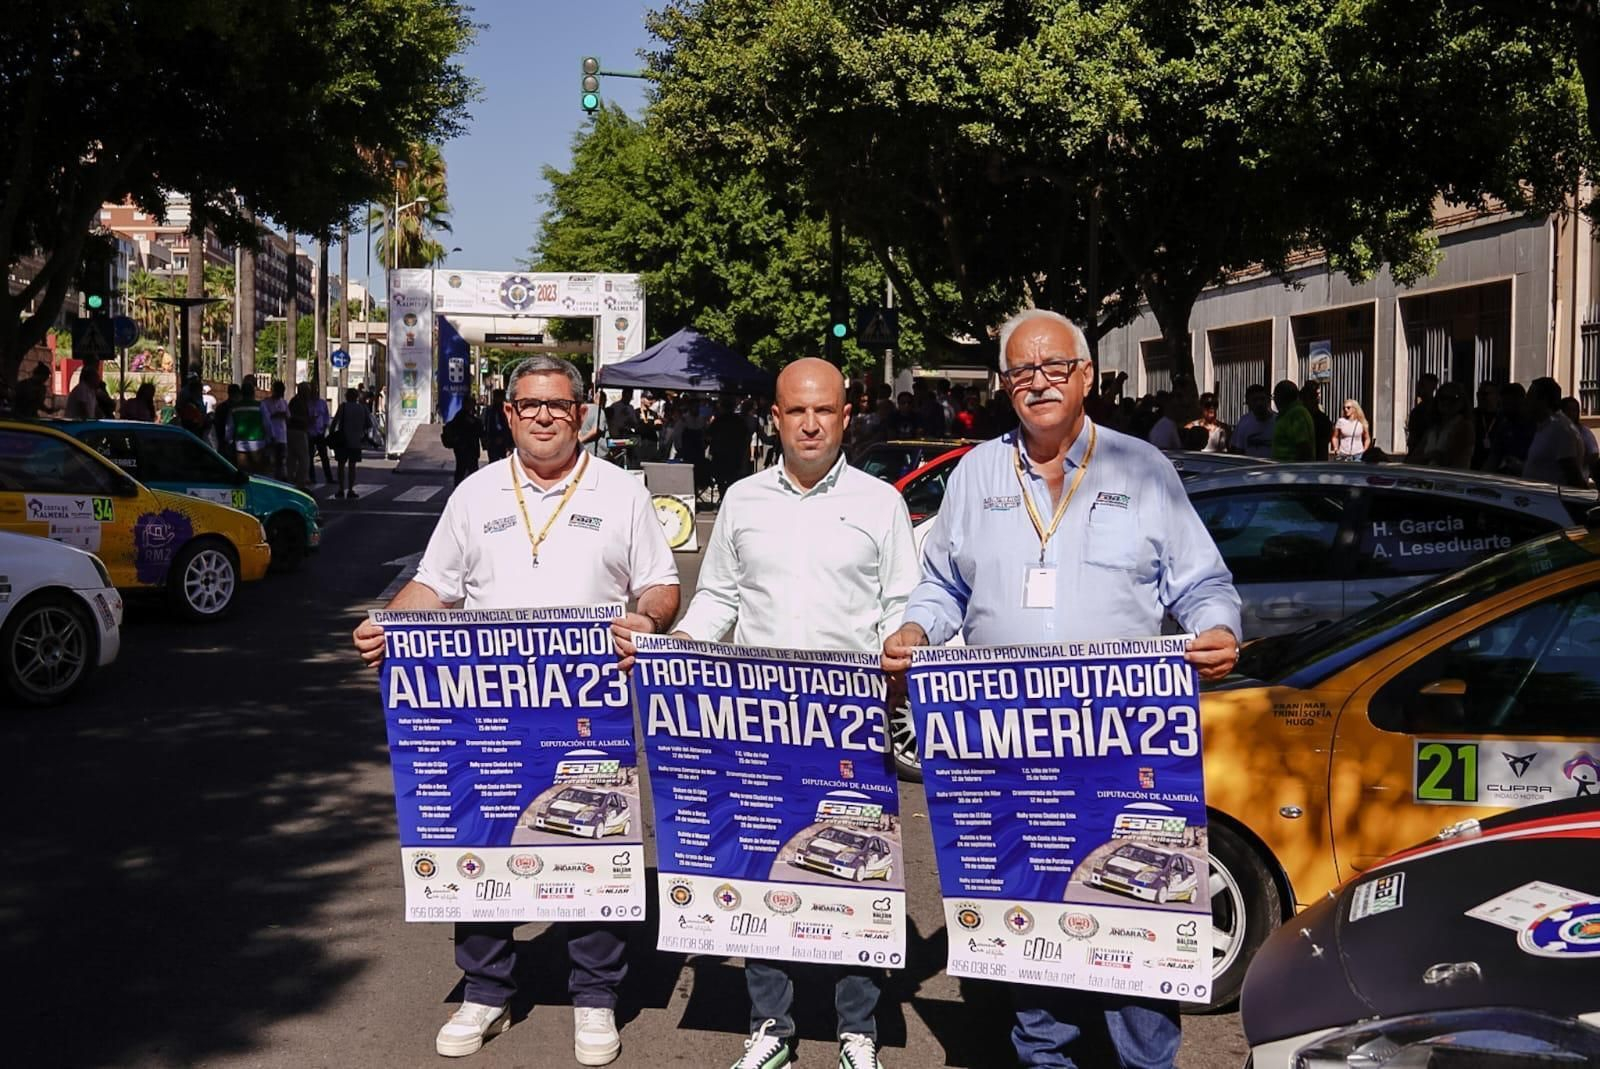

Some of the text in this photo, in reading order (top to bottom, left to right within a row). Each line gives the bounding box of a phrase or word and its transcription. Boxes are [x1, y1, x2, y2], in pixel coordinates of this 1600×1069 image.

[537, 284, 557, 302] 2023
[232, 490, 245, 508] 30
[93, 498, 112, 520] 34
[1373, 522, 1392, 537] H.
[1373, 534, 1512, 558] A. Leseduarte
[375, 605, 622, 622] CAMPEONATO PROVINCIAL DE AUTOMOVILISMO
[384, 630, 472, 658] TROFEO
[636, 636, 880, 666] CAMPEONATO PROVINCIAL DE AUTOMOVILISM
[911, 648, 992, 663] CAMPEONATO
[994, 644, 1067, 659] PROVINCIAL
[1070, 643, 1084, 656] DE
[388, 656, 629, 708] ALMERÍA'23
[636, 658, 888, 702] TROFEO DIPUTACIÓN
[911, 658, 1194, 704] TROFEO DIPUTACIÓN
[648, 694, 891, 753] ALMERÍA'23
[924, 699, 1198, 759] ALMERÍA'23
[1286, 718, 1314, 726] HUGO
[540, 738, 585, 747] DIPUTACIÓN
[597, 738, 630, 747] ALMERÍA
[1418, 744, 1476, 800] 21
[801, 778, 848, 788] DIPUTACIÓN
[861, 783, 893, 793] ALMERÍA
[1487, 784, 1552, 793] CUPRA
[1097, 791, 1148, 799] DIPUTACIÓN
[1162, 793, 1198, 802] ALMERÍA
[410, 906, 426, 918] 956
[446, 906, 460, 918] 586
[698, 939, 714, 951] 586
[952, 960, 1006, 976] 956 038 586
